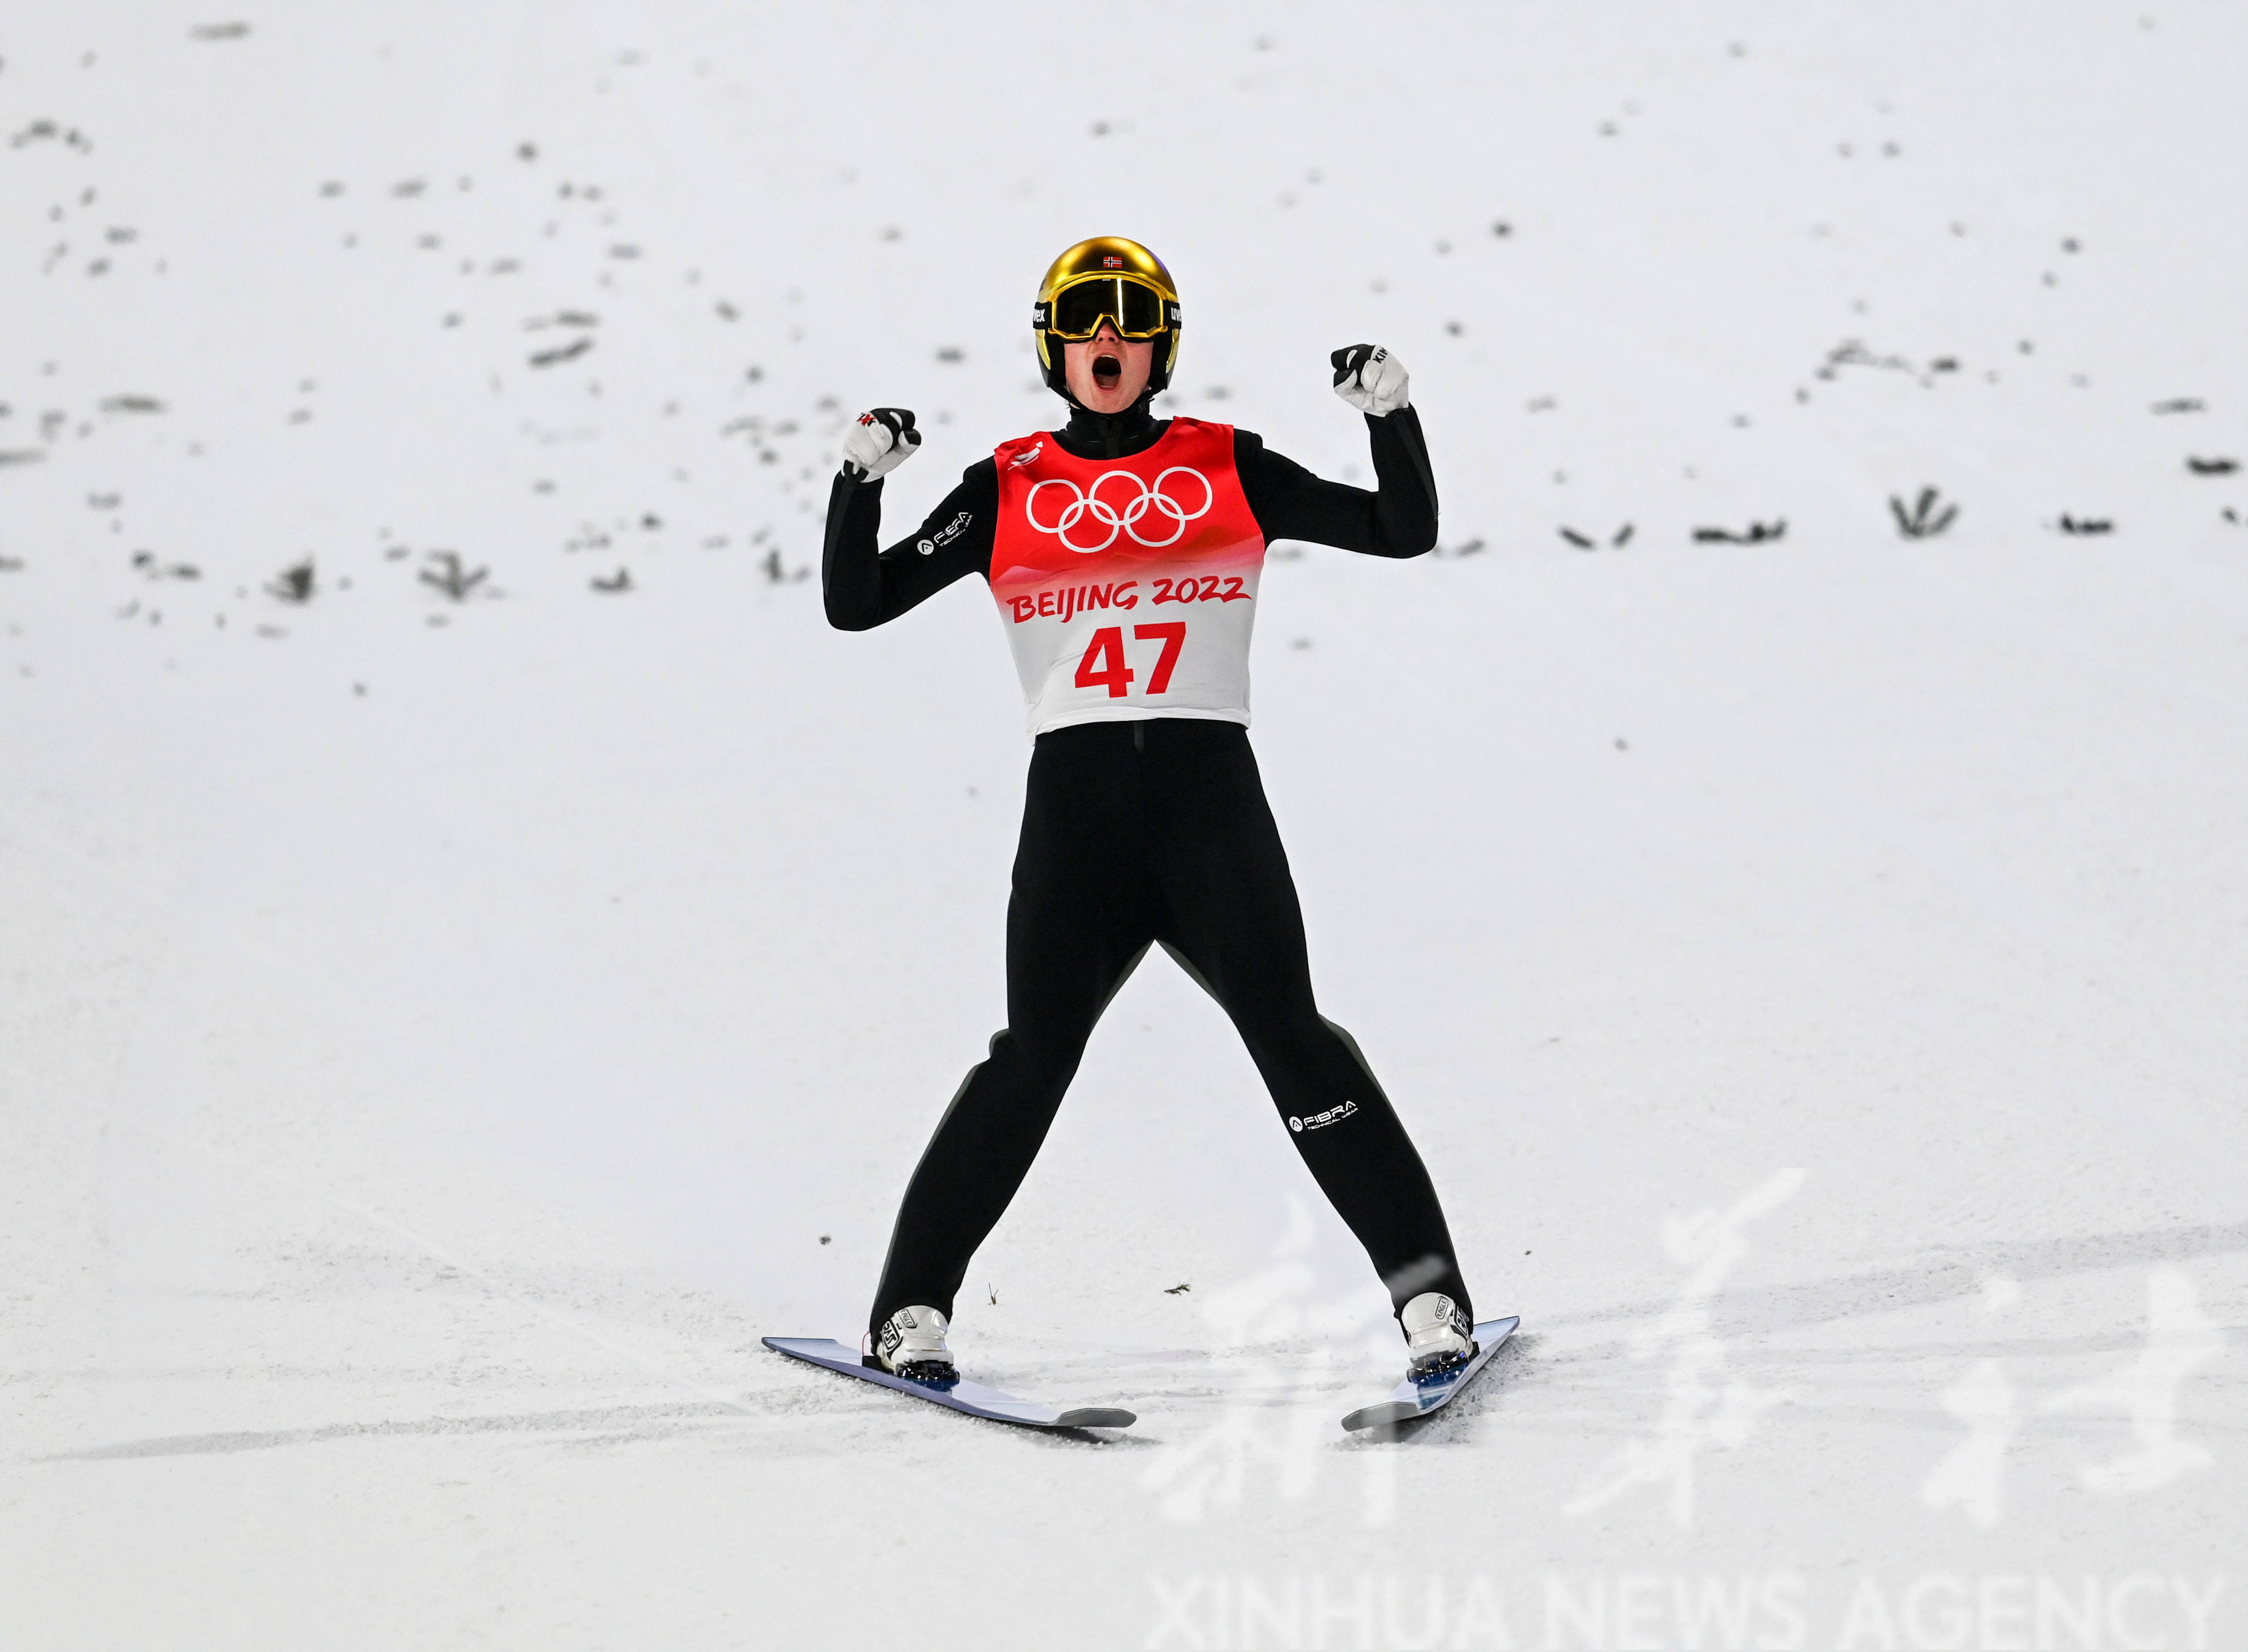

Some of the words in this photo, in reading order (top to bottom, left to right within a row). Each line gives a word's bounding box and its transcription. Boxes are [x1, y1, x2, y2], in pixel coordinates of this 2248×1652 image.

[1006, 580, 1139, 623] BEIJING
[1151, 575, 1252, 603] 2022
[1075, 621, 1186, 698] 47
[1303, 1100, 1356, 1126] FIBRA
